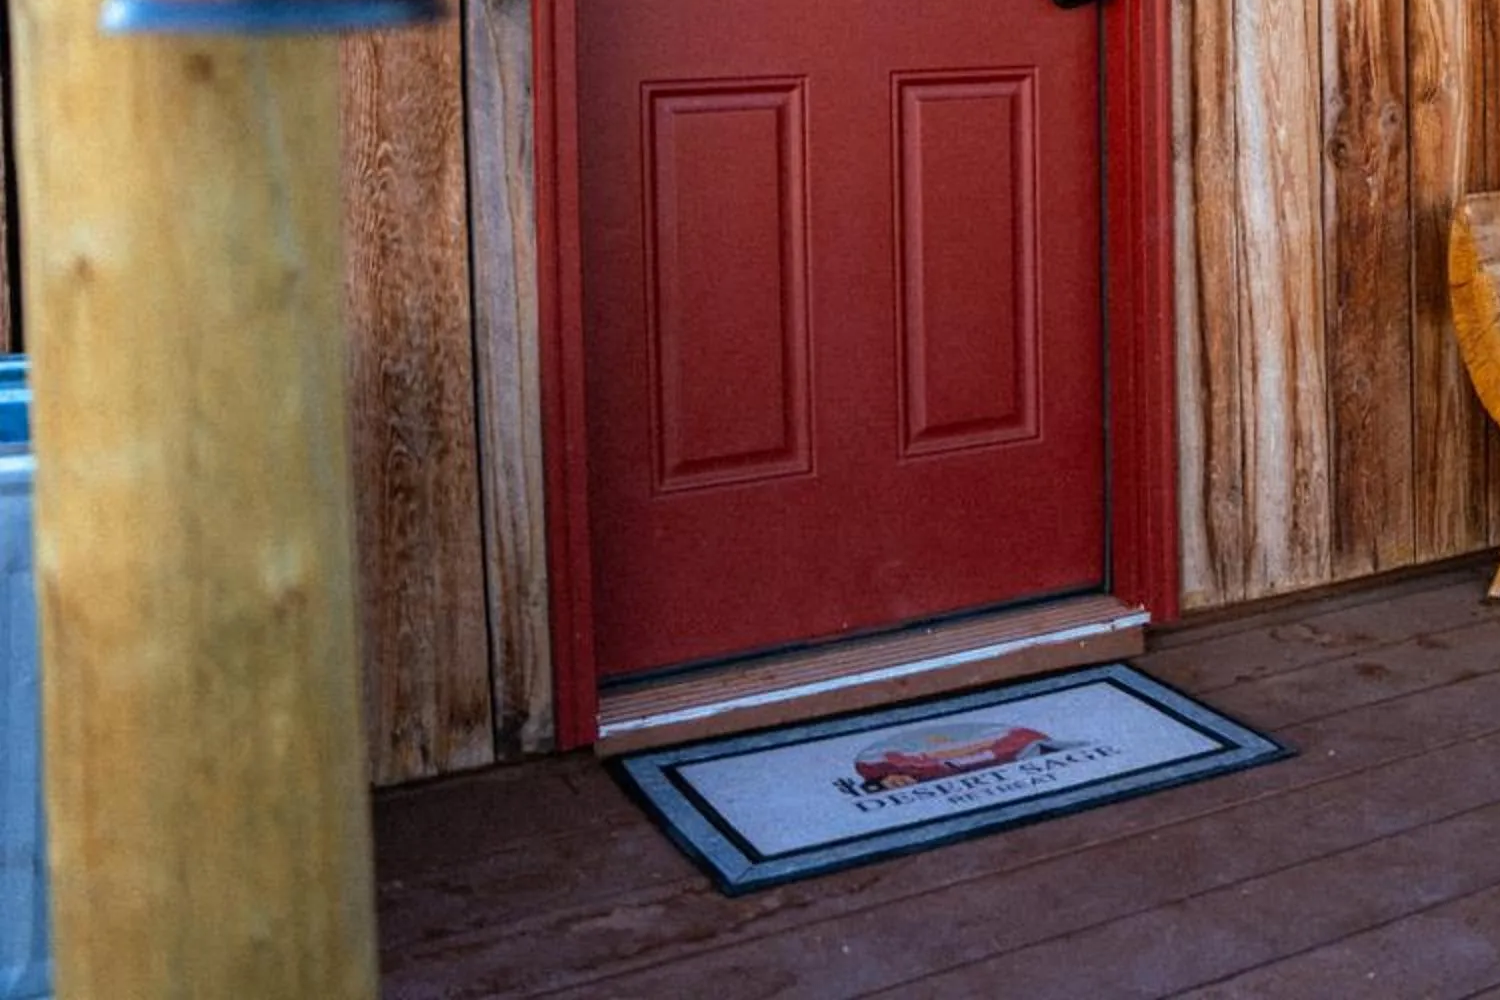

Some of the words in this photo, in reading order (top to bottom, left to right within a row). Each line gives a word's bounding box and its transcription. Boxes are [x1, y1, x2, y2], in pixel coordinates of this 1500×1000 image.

[856, 770, 1009, 813] DESERT
[1018, 744, 1121, 773] SAGE
[948, 773, 1059, 806] RETREAT
